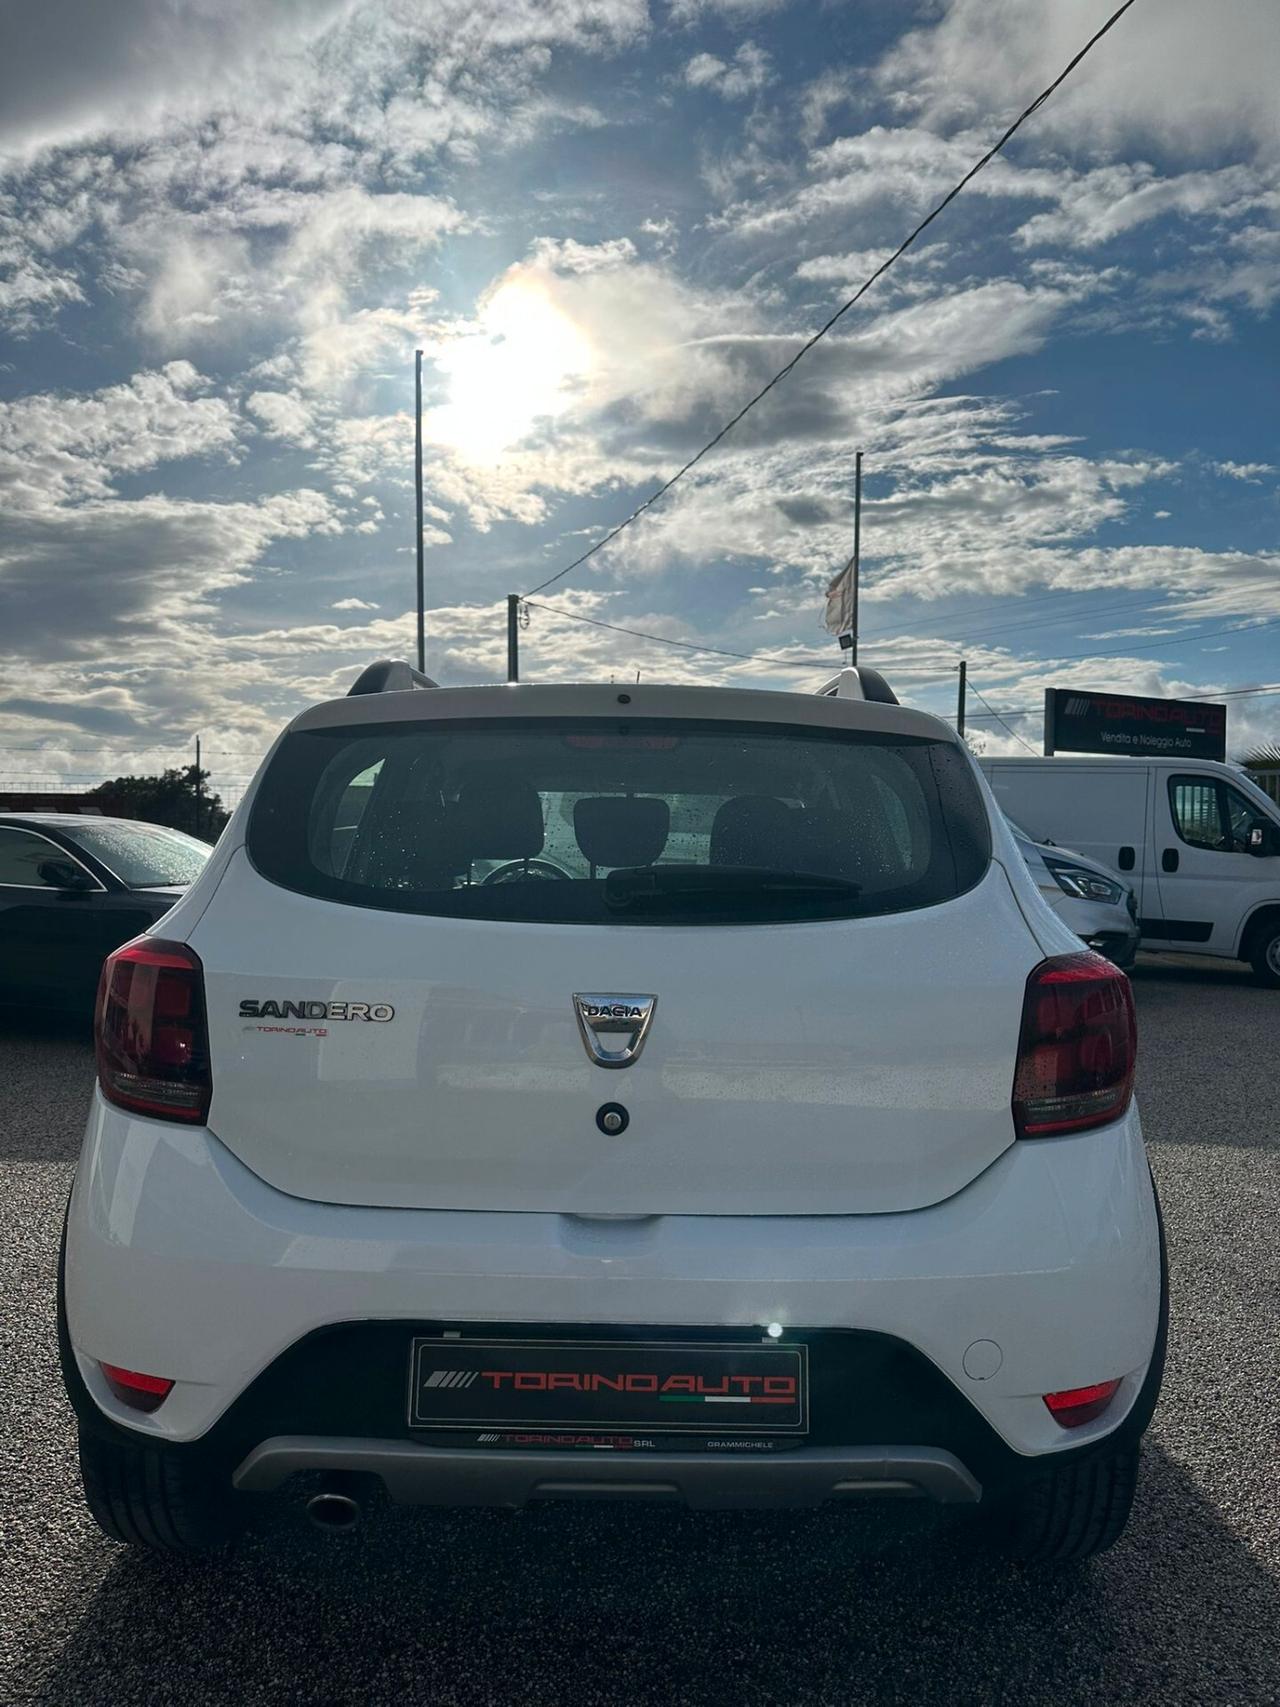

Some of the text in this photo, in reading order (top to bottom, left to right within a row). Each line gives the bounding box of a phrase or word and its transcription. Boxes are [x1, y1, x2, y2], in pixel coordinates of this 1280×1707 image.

[1100, 731, 1192, 749] Vendita e Noleggio Auto
[239, 999, 395, 1023] SANDERO
[588, 1006, 642, 1017] DACIA
[256, 1026, 328, 1035] TORINOAUTO
[481, 1371, 796, 1394] TORINOAUTO
[502, 1433, 656, 1448] TORINOAUTO SRL
[707, 1440, 774, 1449] GRAMMICHELE
